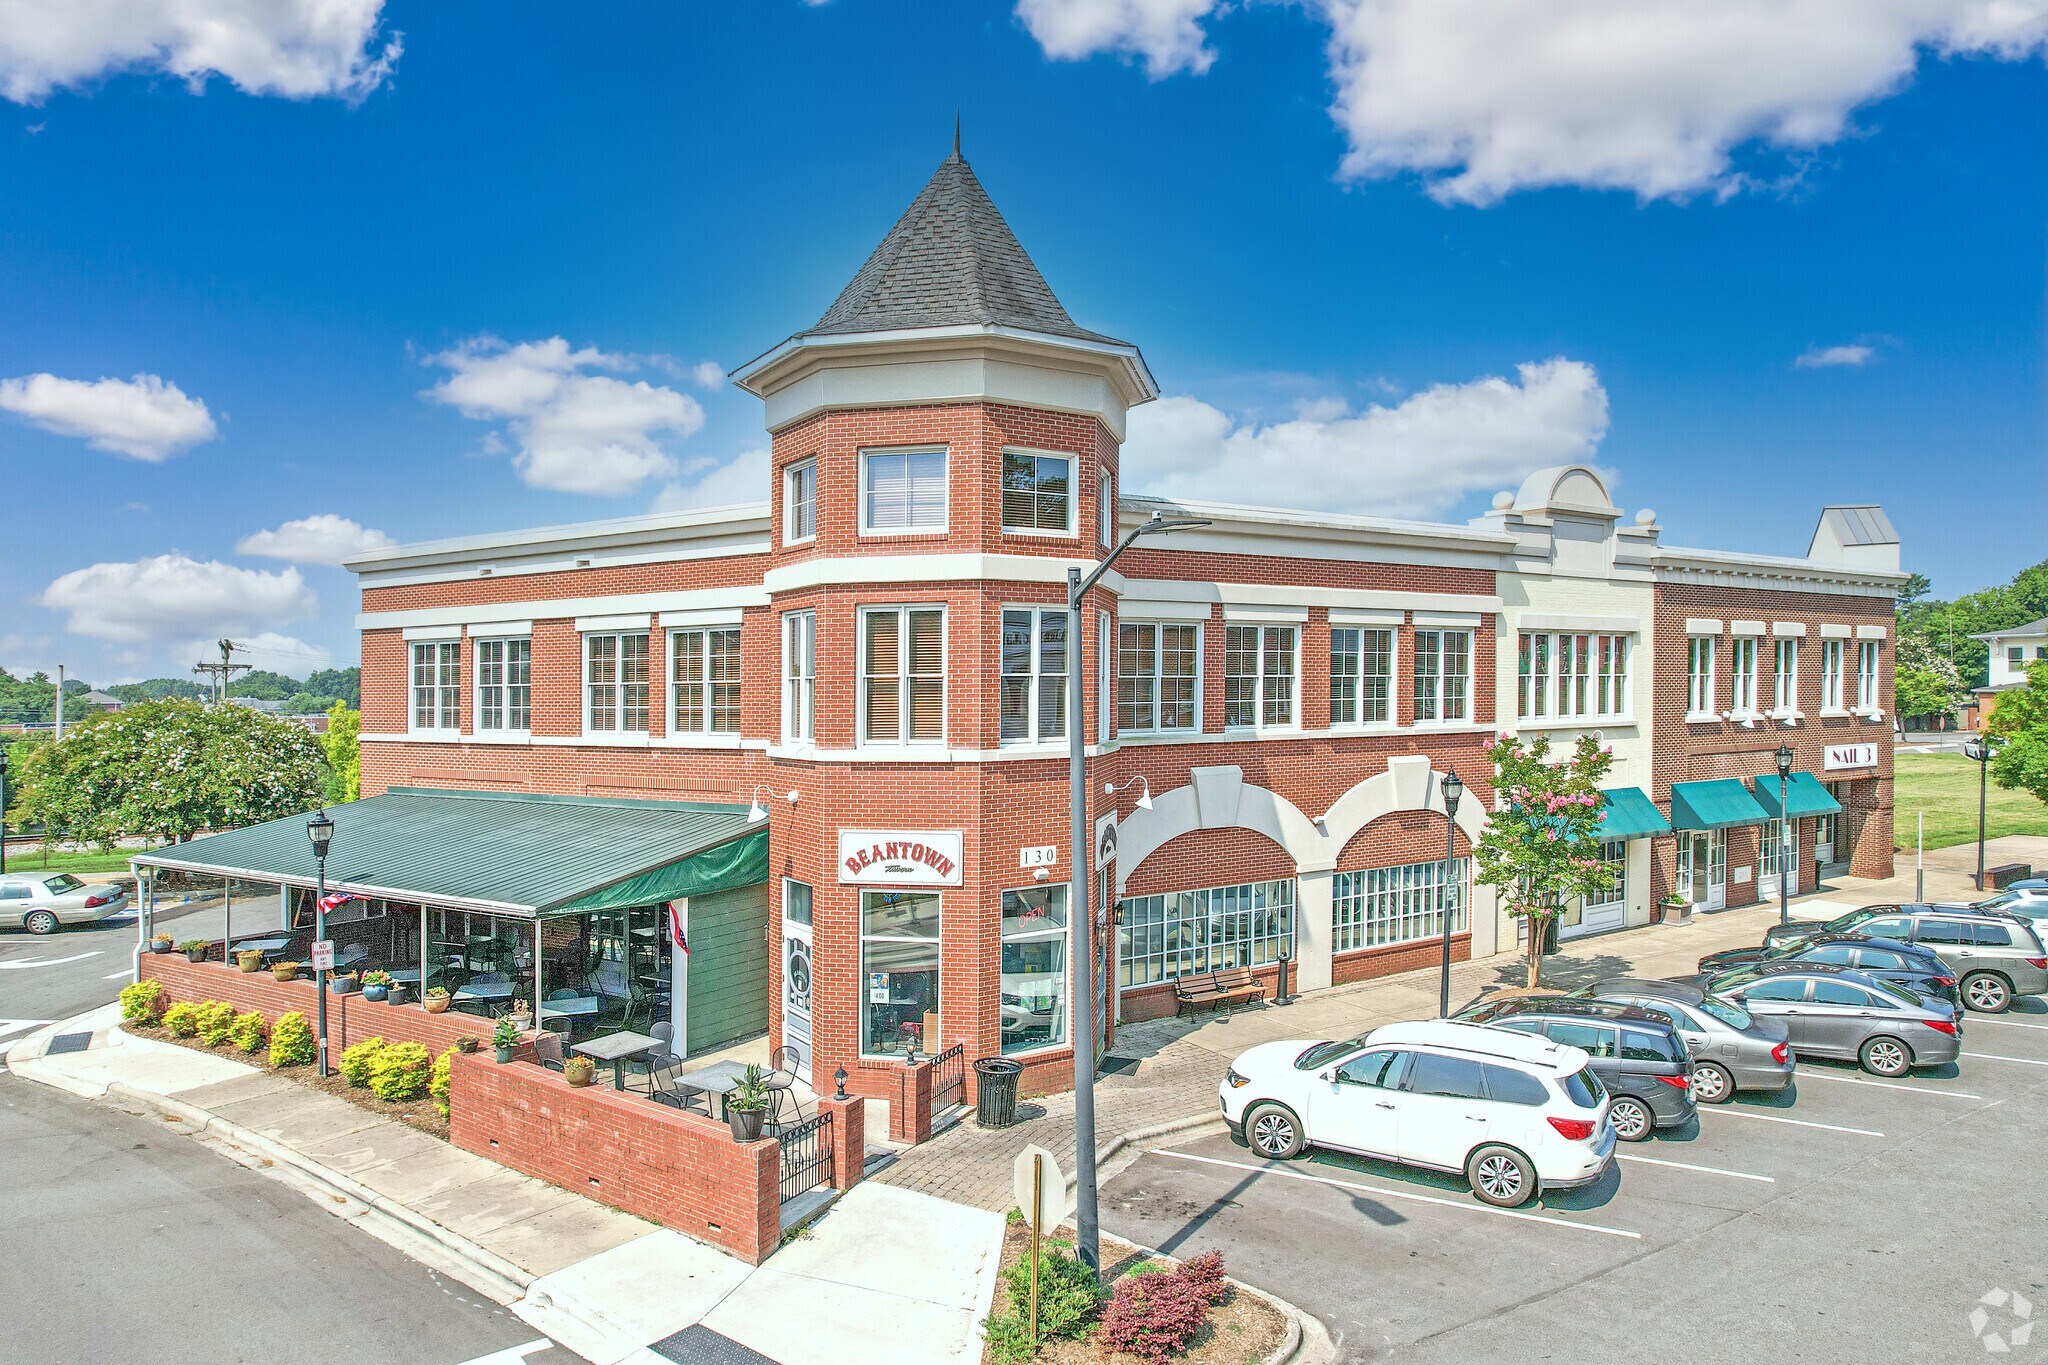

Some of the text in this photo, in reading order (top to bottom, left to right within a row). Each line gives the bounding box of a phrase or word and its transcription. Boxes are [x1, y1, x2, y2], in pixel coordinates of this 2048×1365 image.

[1832, 747, 1871, 765] NAIL 3
[844, 841, 956, 878] BEANTOWN
[1024, 848, 1054, 864] 130
[1018, 904, 1045, 928] OPEN
